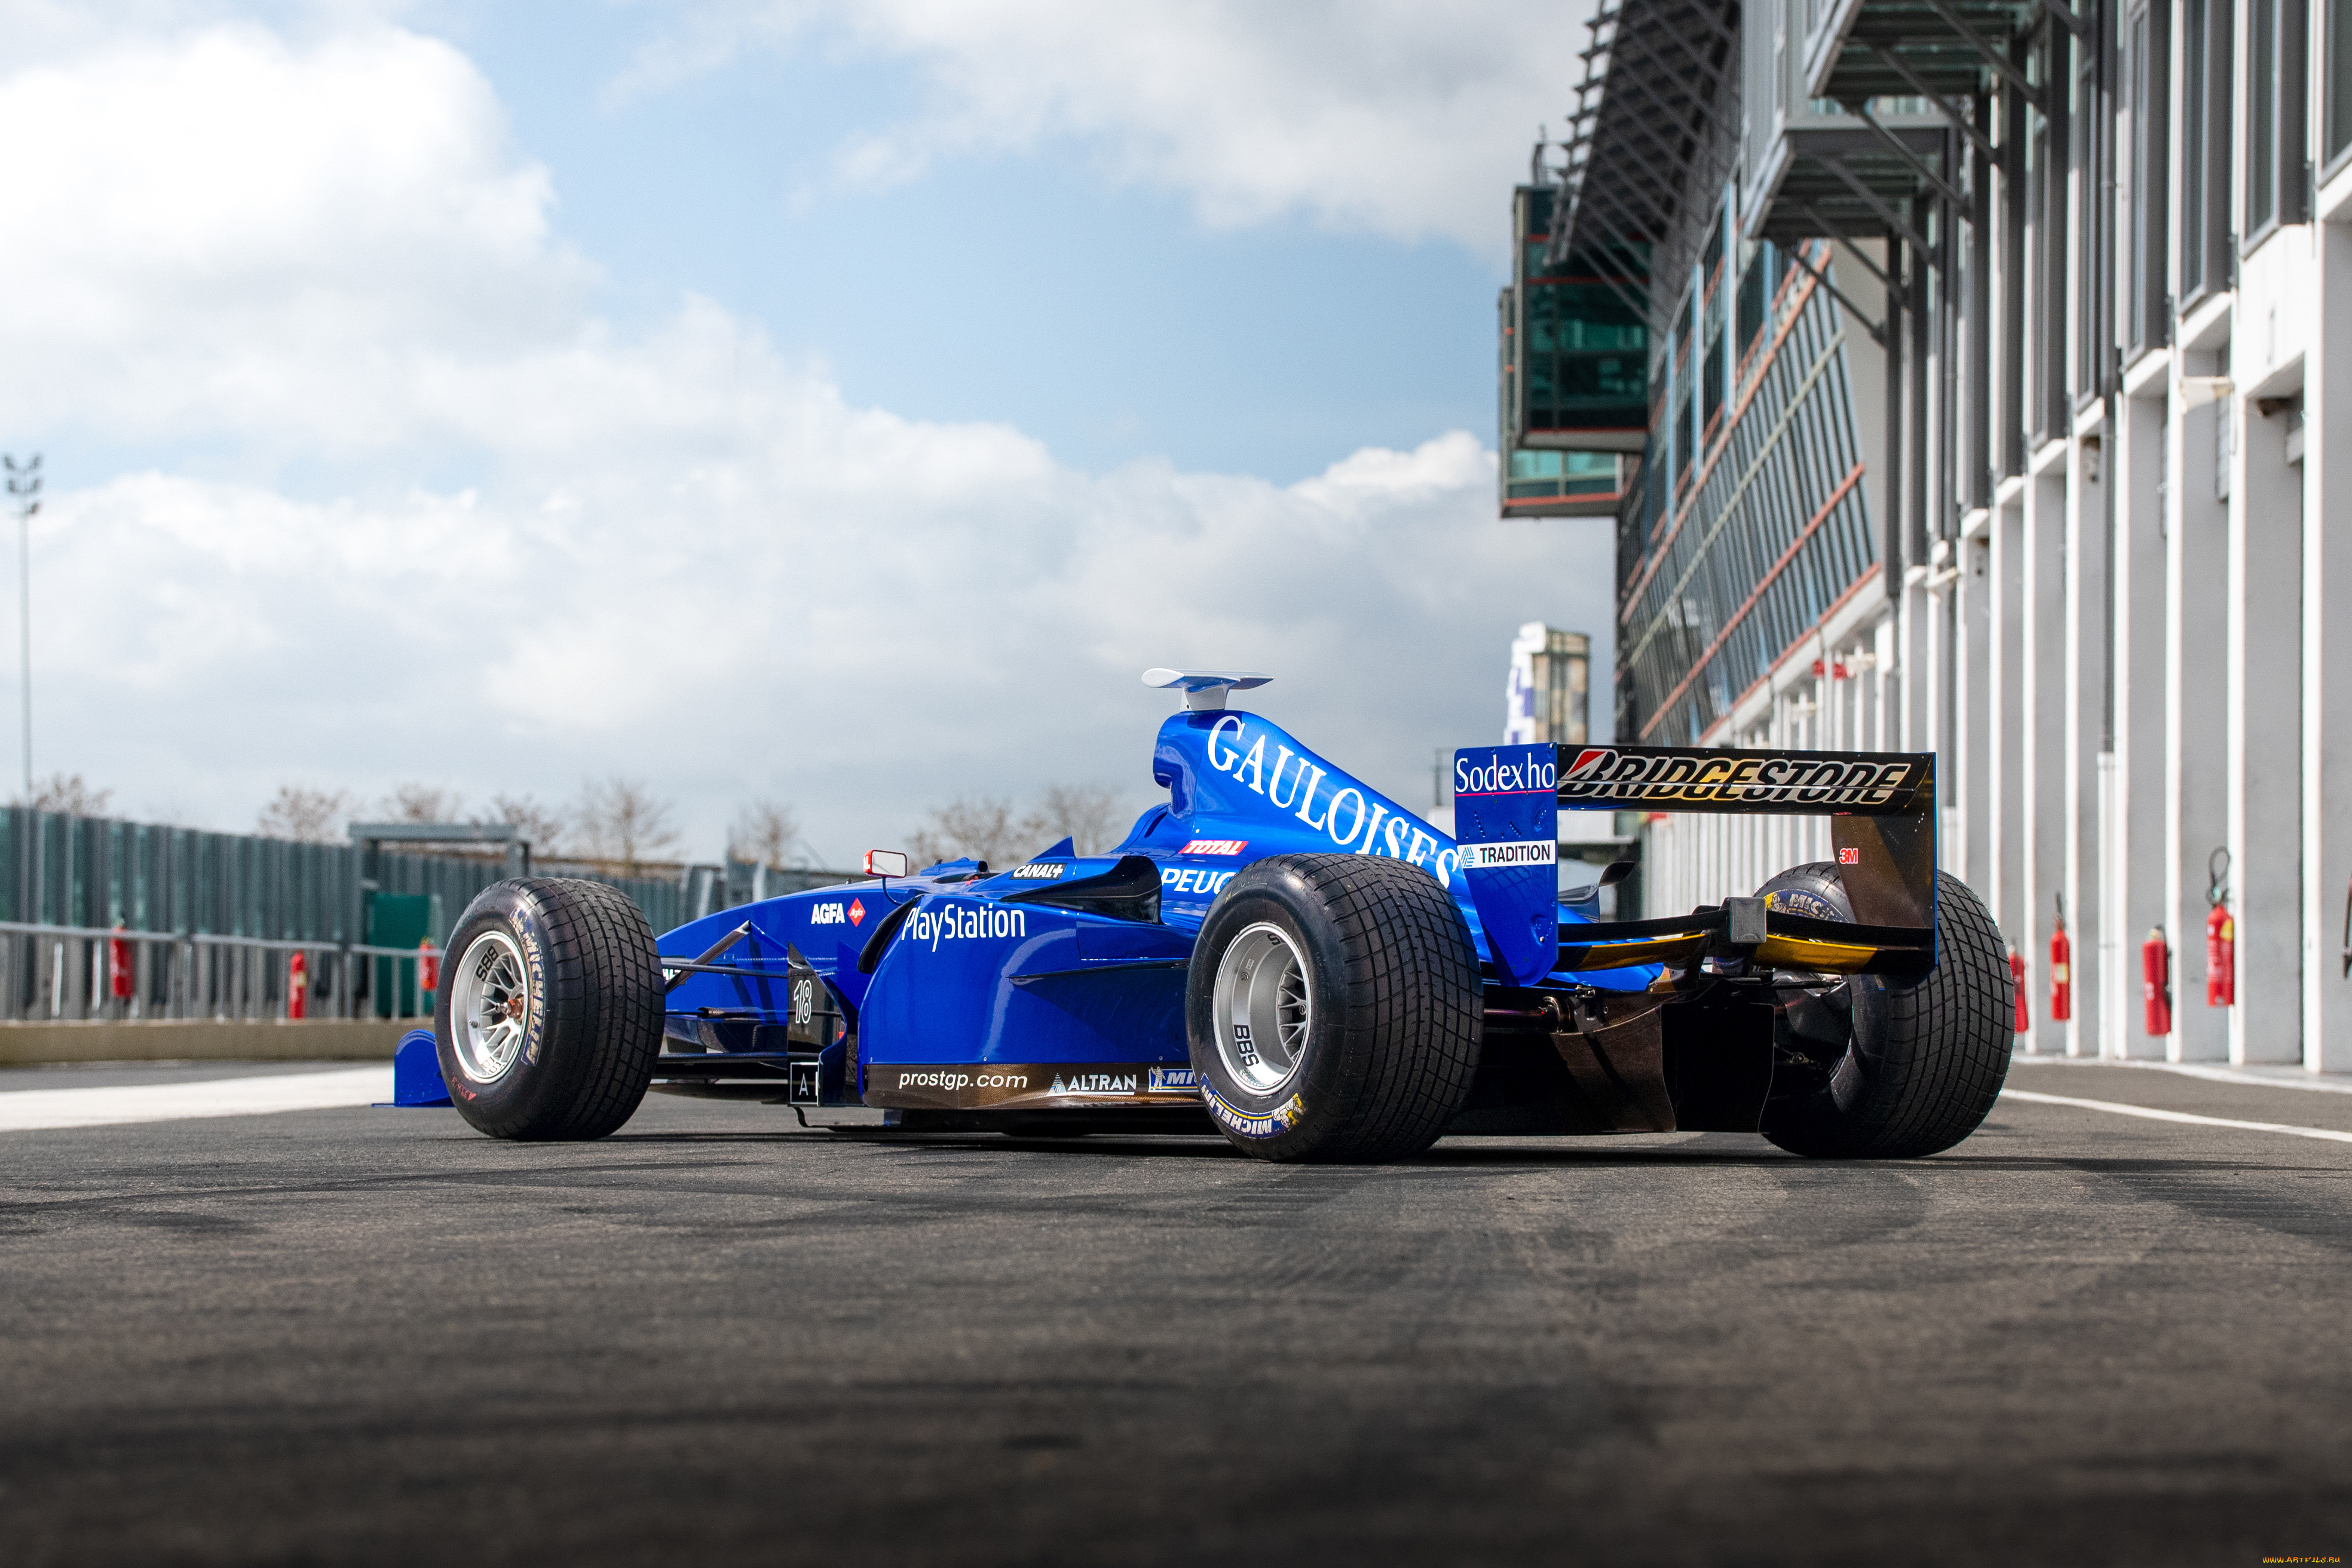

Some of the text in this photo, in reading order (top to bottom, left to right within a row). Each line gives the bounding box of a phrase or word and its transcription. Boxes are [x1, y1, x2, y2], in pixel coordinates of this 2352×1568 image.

[1455, 752, 1555, 792] Sodexho
[1557, 748, 1911, 804] BRIDGESTONE
[1207, 715, 1459, 889] GAULOISES
[1184, 840, 1242, 855] TOTAL
[1480, 844, 1550, 863] TRADITION
[1839, 848, 1858, 864] 3M
[1012, 864, 1064, 879] CANAL+
[811, 903, 846, 924] AGFA
[849, 908, 863, 918] Agfa
[901, 902, 1025, 952] PlayStation
[476, 945, 499, 982] BBS
[794, 979, 812, 1024] 18
[1233, 1024, 1260, 1068] BBS
[899, 1071, 1028, 1090] prostgp.com
[1067, 1074, 1137, 1092] ALTRAN
[1200, 1084, 1272, 1135] MICHELIN
